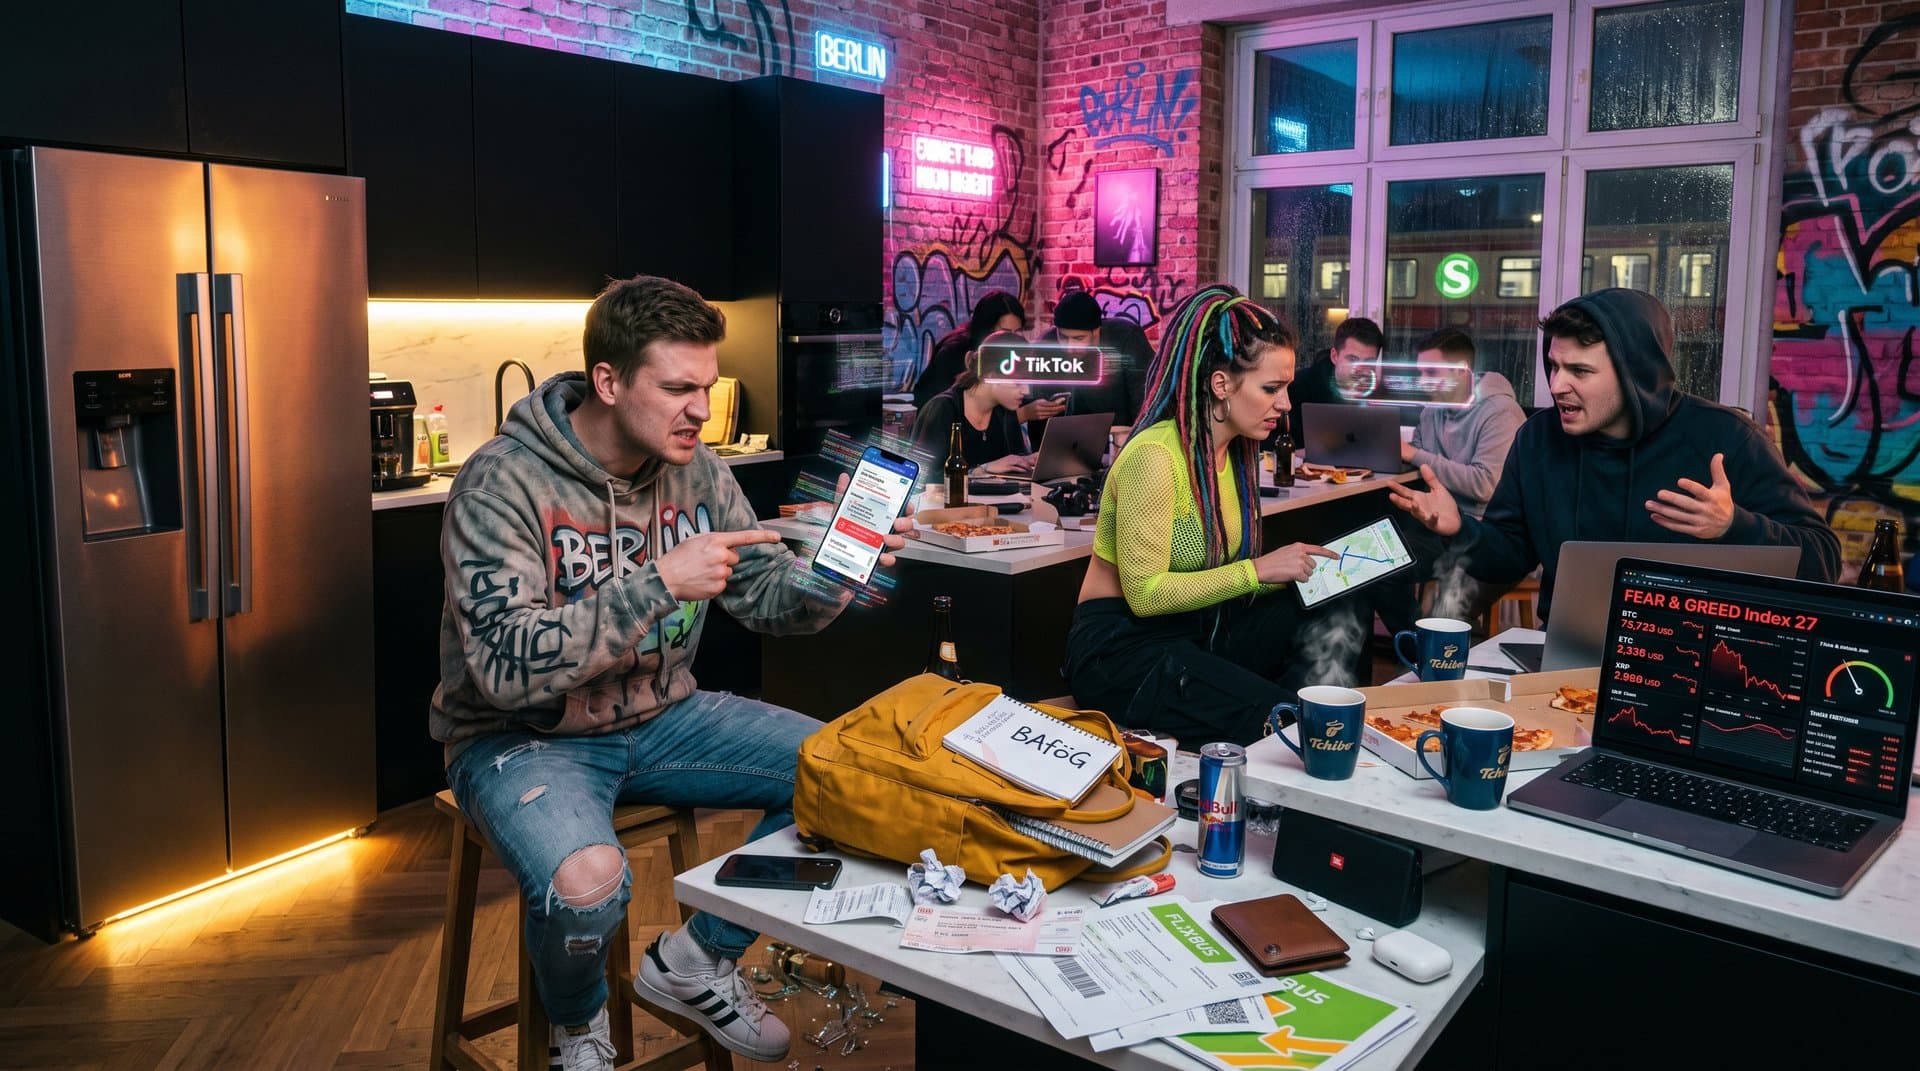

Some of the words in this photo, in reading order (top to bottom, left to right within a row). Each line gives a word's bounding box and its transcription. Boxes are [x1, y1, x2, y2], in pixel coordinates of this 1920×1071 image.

[820, 34, 887, 80] BERLIN
[1443, 260, 1470, 294] S
[1622, 610, 1638, 618] BTC
[1624, 589, 1666, 607] FEAR
[1668, 595, 1680, 610] &
[1684, 599, 1741, 619] GREED
[1744, 607, 1791, 627] Index
[1794, 615, 1818, 631] 27
[1657, 627, 1674, 636] USD
[1618, 636, 1633, 644] ETC
[1648, 652, 1664, 661] USD
[1430, 658, 1465, 669] Tchibo
[1615, 662, 1630, 670] XRP
[1645, 678, 1661, 688] USD
[1309, 738, 1354, 751] Tchibo
[1211, 801, 1238, 815] Bull
